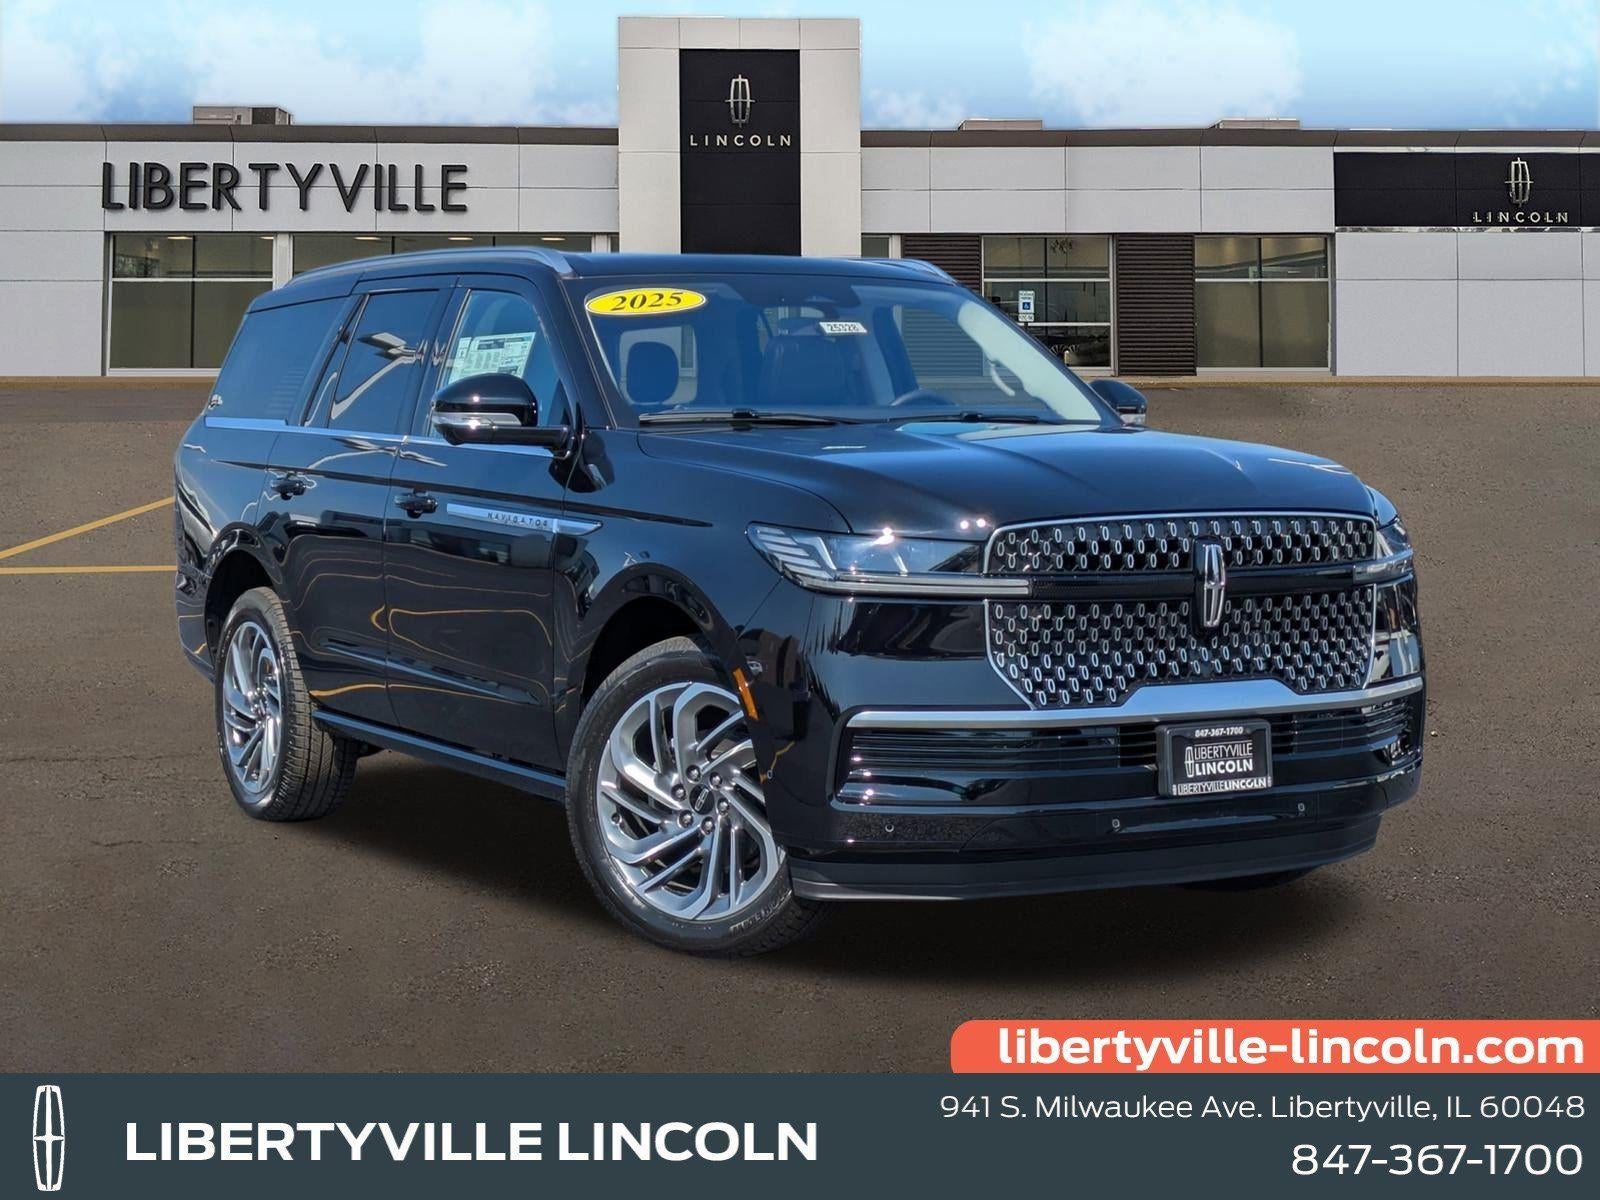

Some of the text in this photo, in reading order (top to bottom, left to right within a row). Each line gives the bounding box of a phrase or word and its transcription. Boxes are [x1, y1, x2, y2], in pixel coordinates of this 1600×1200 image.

[690, 134, 791, 147] LINCOLN
[102, 161, 469, 214] LIBERTYVILLE
[1472, 210, 1569, 225] LINCOLN
[611, 290, 684, 311] 2025
[487, 511, 549, 528] NAVIGATOR
[1194, 726, 1244, 738] 847-367-1700
[1194, 742, 1254, 760] LIBERTYVILLE
[1195, 758, 1254, 776] LINCOLN
